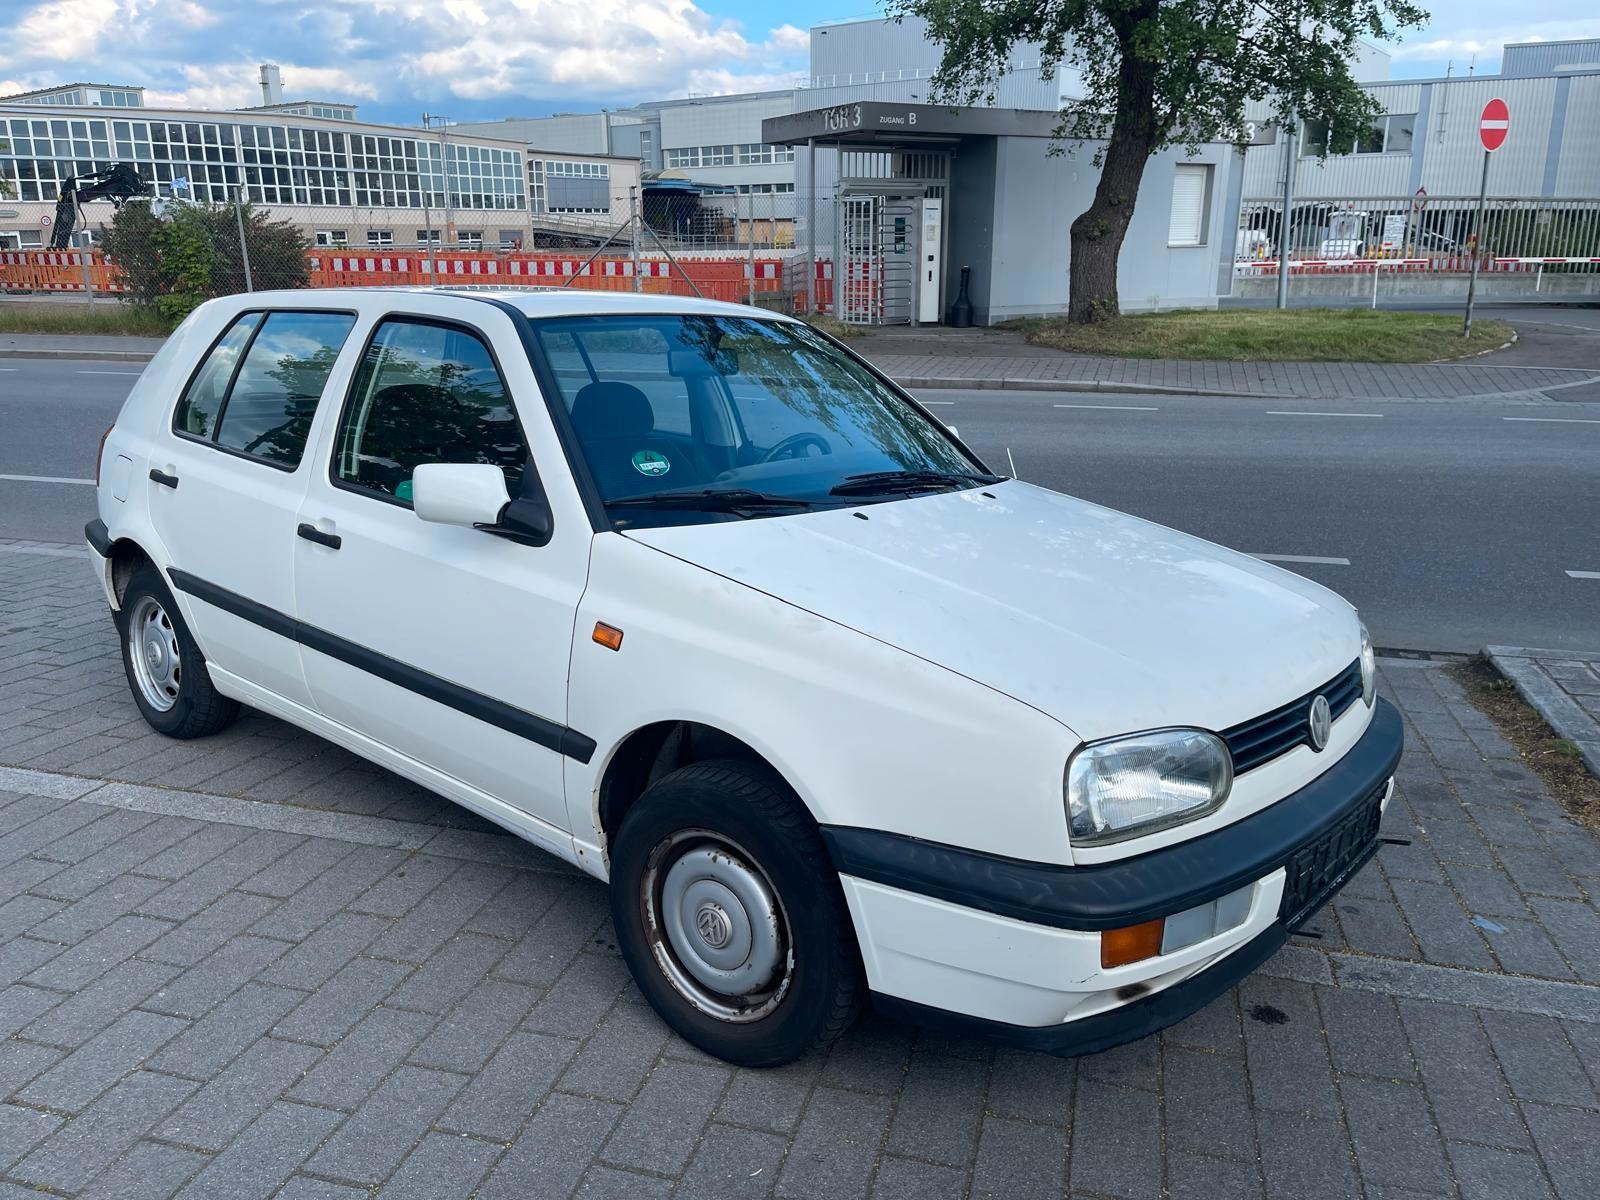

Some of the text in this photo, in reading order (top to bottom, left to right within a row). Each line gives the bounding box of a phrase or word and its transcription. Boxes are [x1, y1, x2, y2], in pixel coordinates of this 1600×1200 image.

[822, 105, 861, 131] TOR 3
[879, 112, 917, 125] ZUGANG B
[1245, 121, 1256, 141] 3
[644, 451, 655, 463] 4
